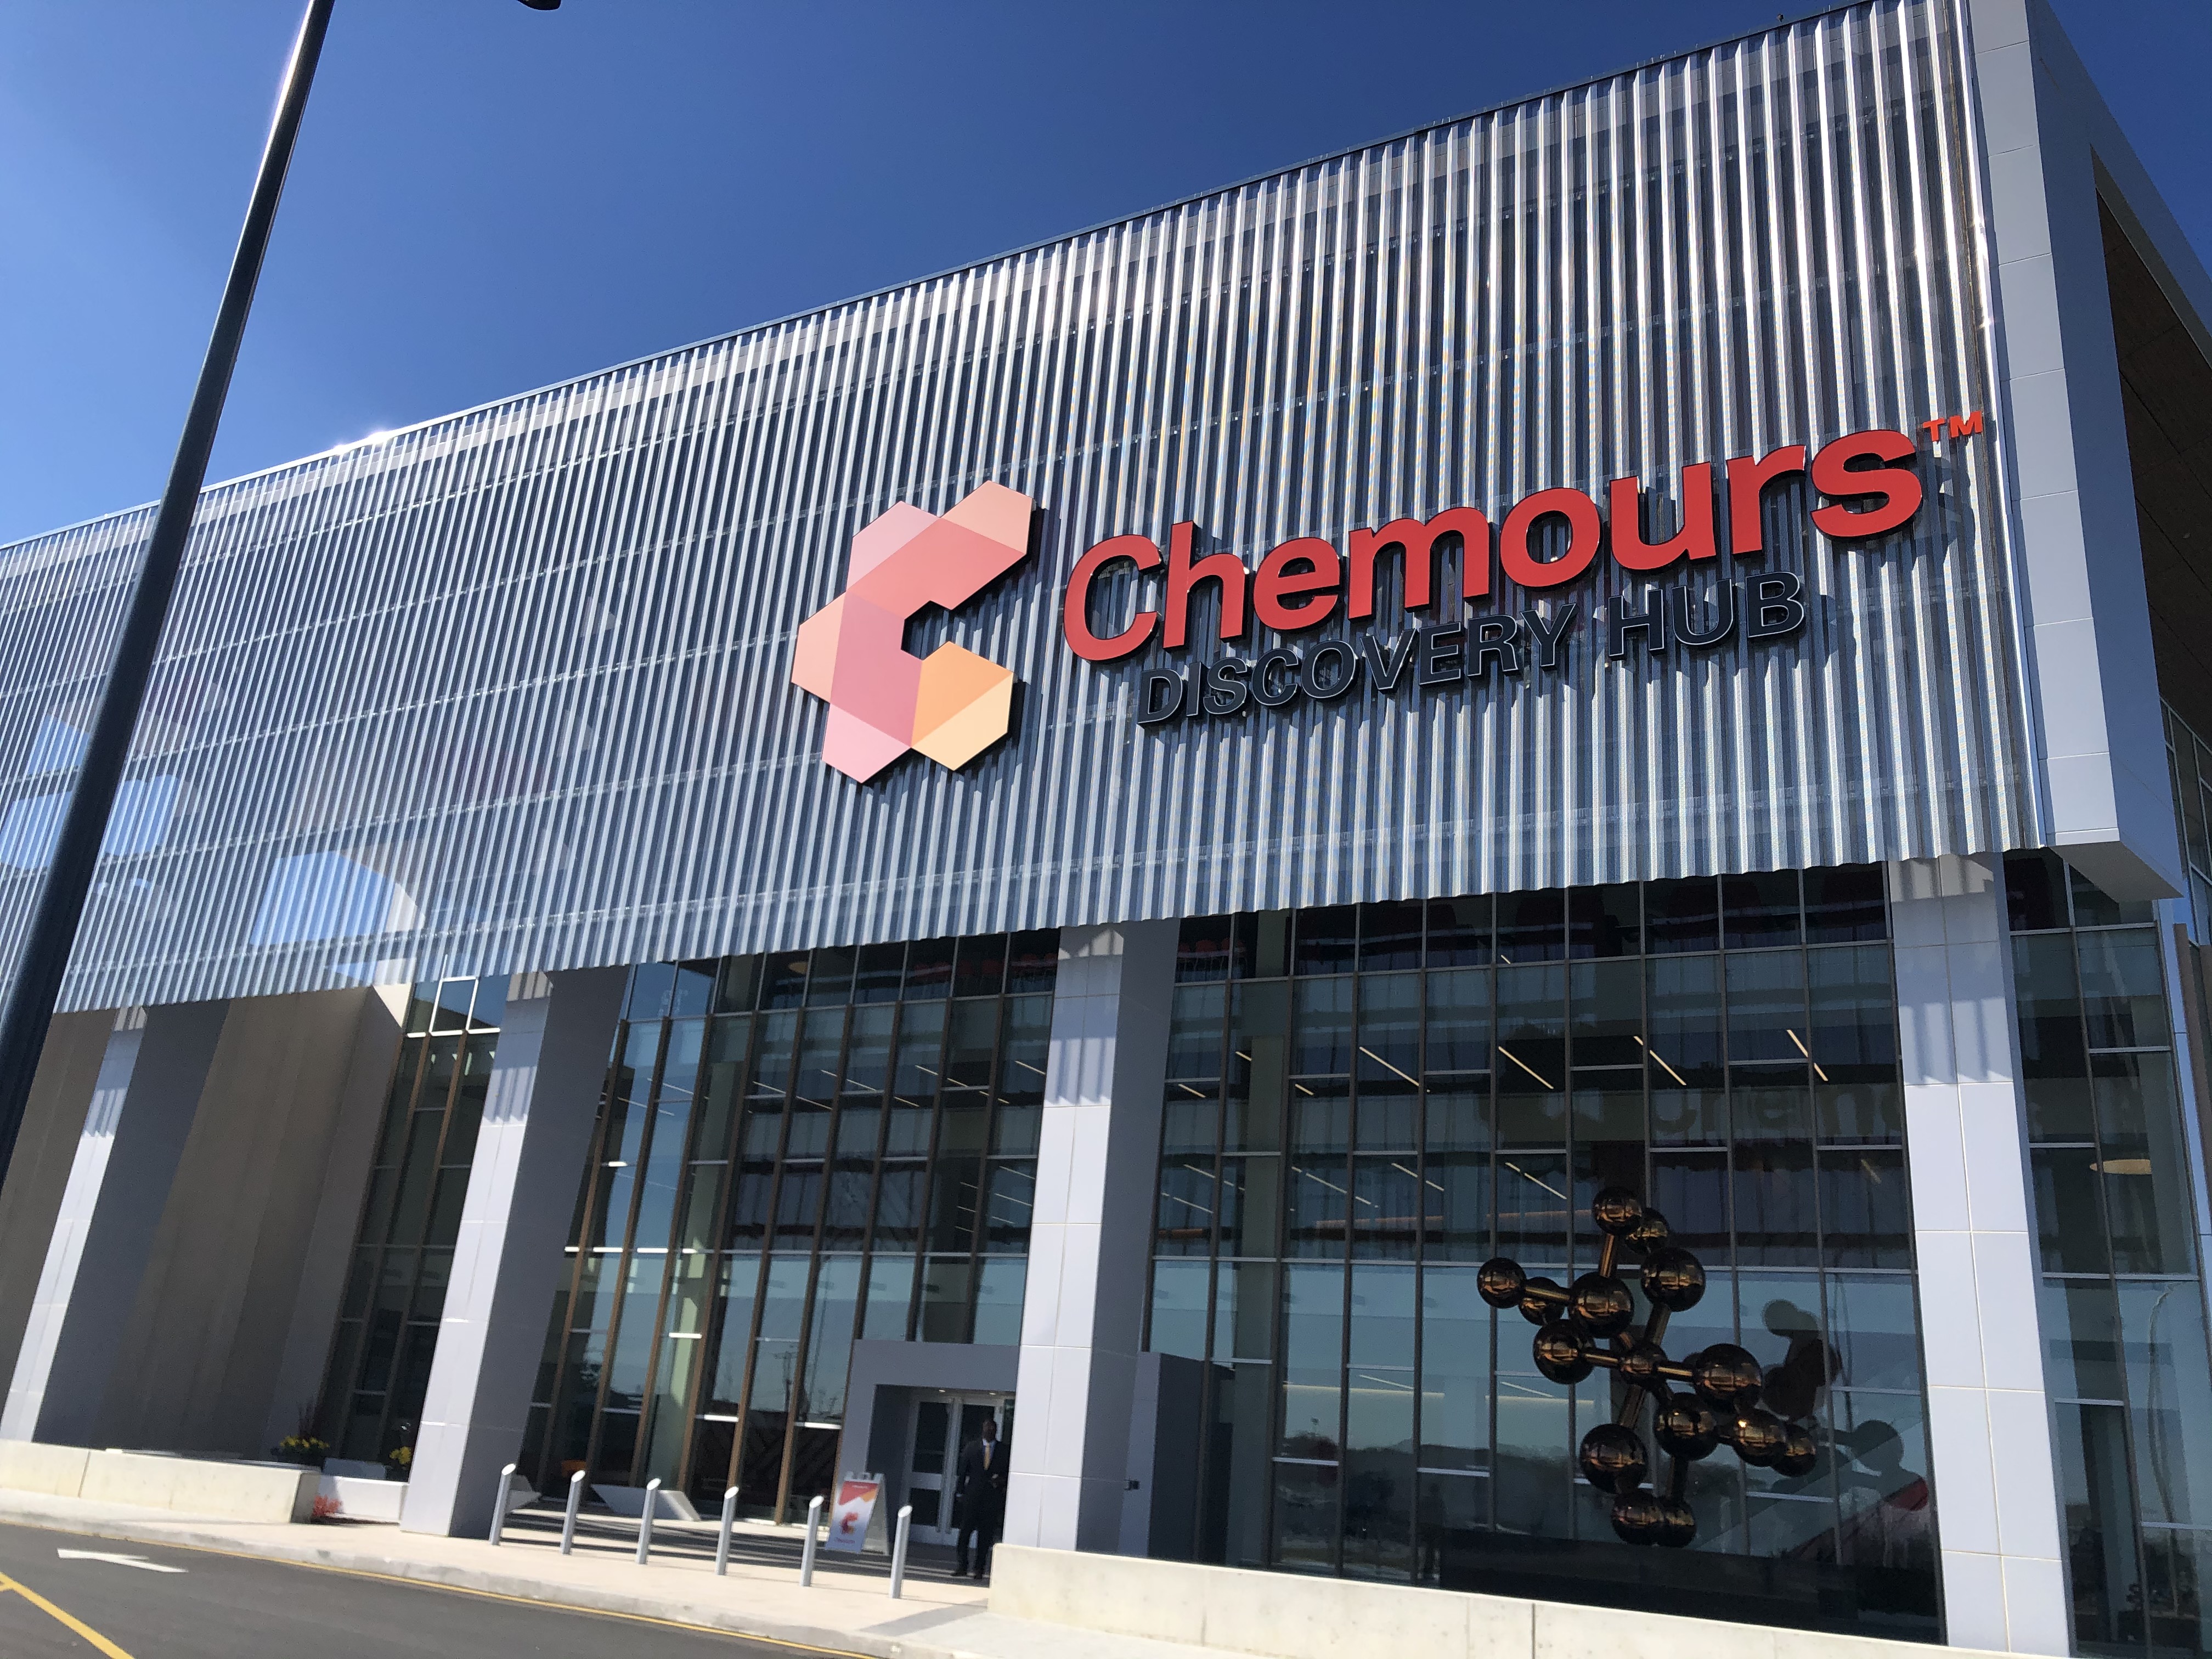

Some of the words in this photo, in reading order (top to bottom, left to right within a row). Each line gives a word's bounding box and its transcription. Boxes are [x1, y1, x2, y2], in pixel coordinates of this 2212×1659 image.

[1064, 430, 1922, 661] Chemours
[1137, 603, 1578, 724] DISCOVERY
[1608, 571, 1805, 657] HUB
